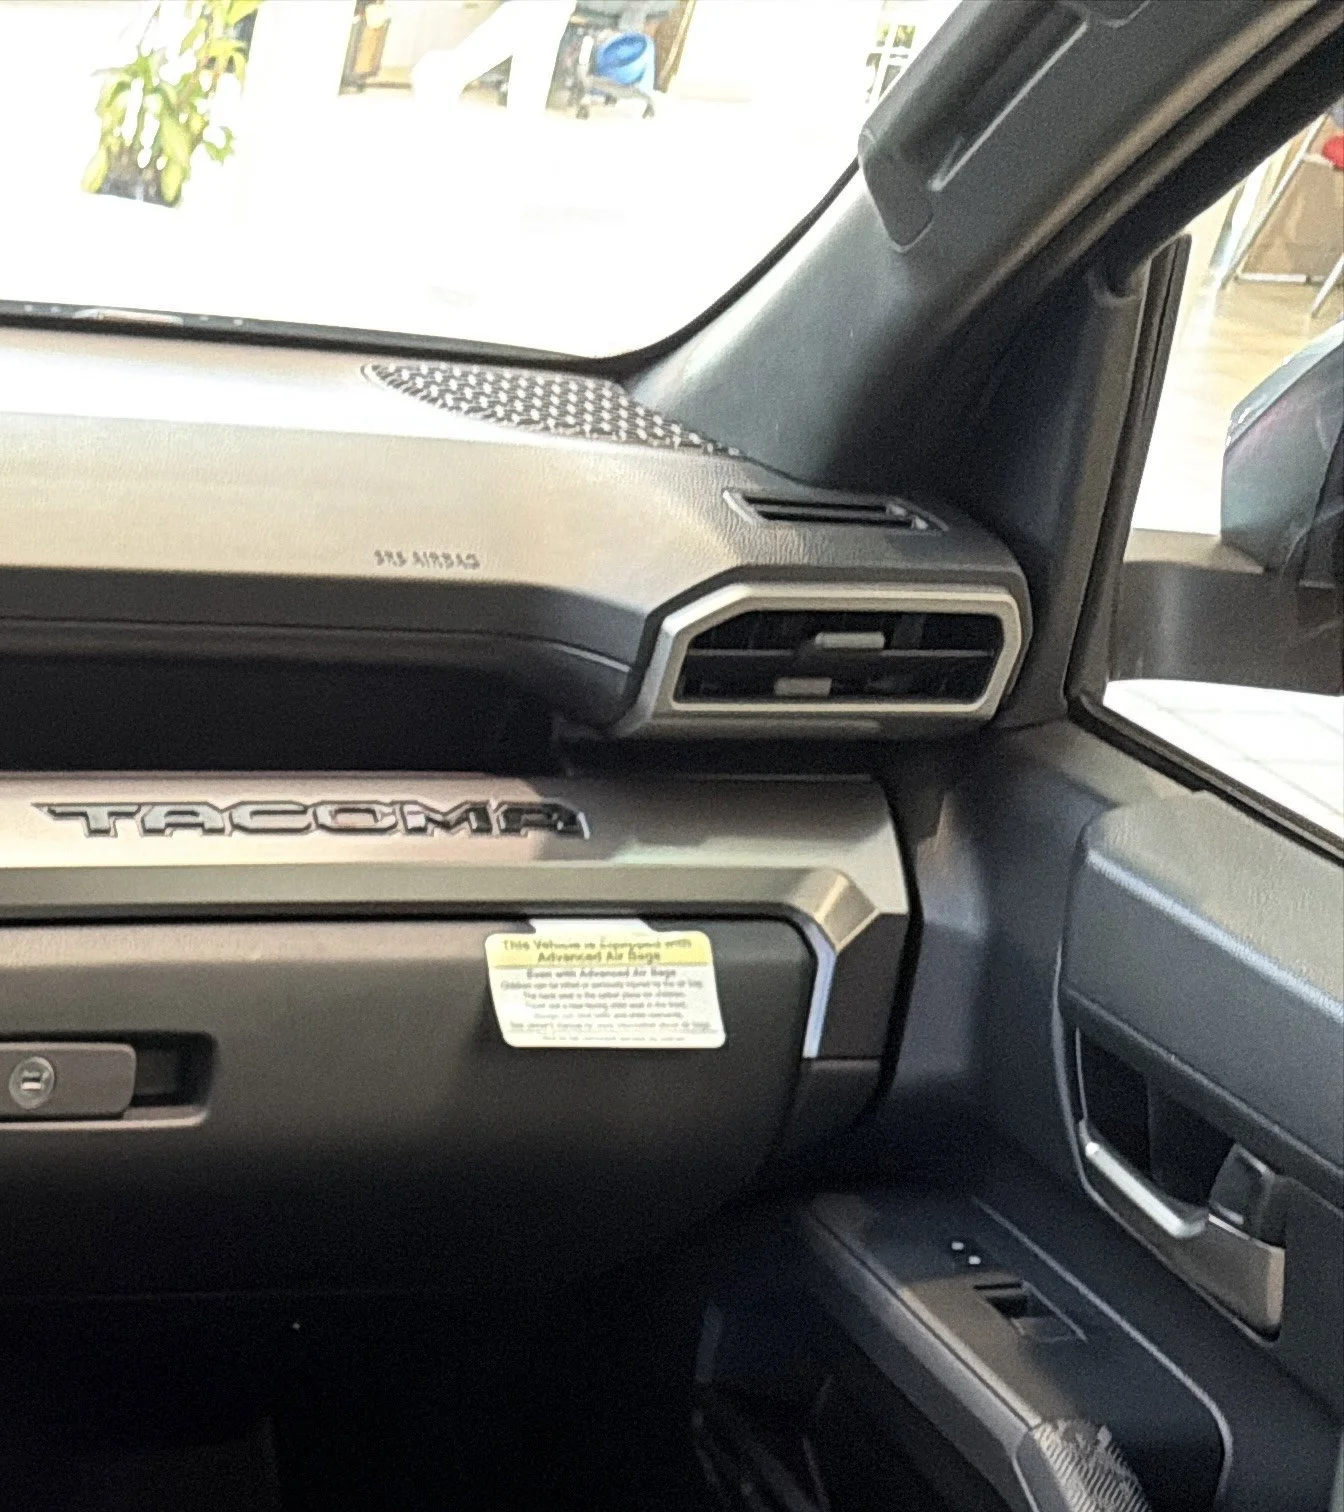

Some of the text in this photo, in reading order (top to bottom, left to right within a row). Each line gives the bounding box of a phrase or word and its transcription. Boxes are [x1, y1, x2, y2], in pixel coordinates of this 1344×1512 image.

[32, 798, 590, 840] TACOMA
[537, 950, 661, 965] Advanced Air Bags
